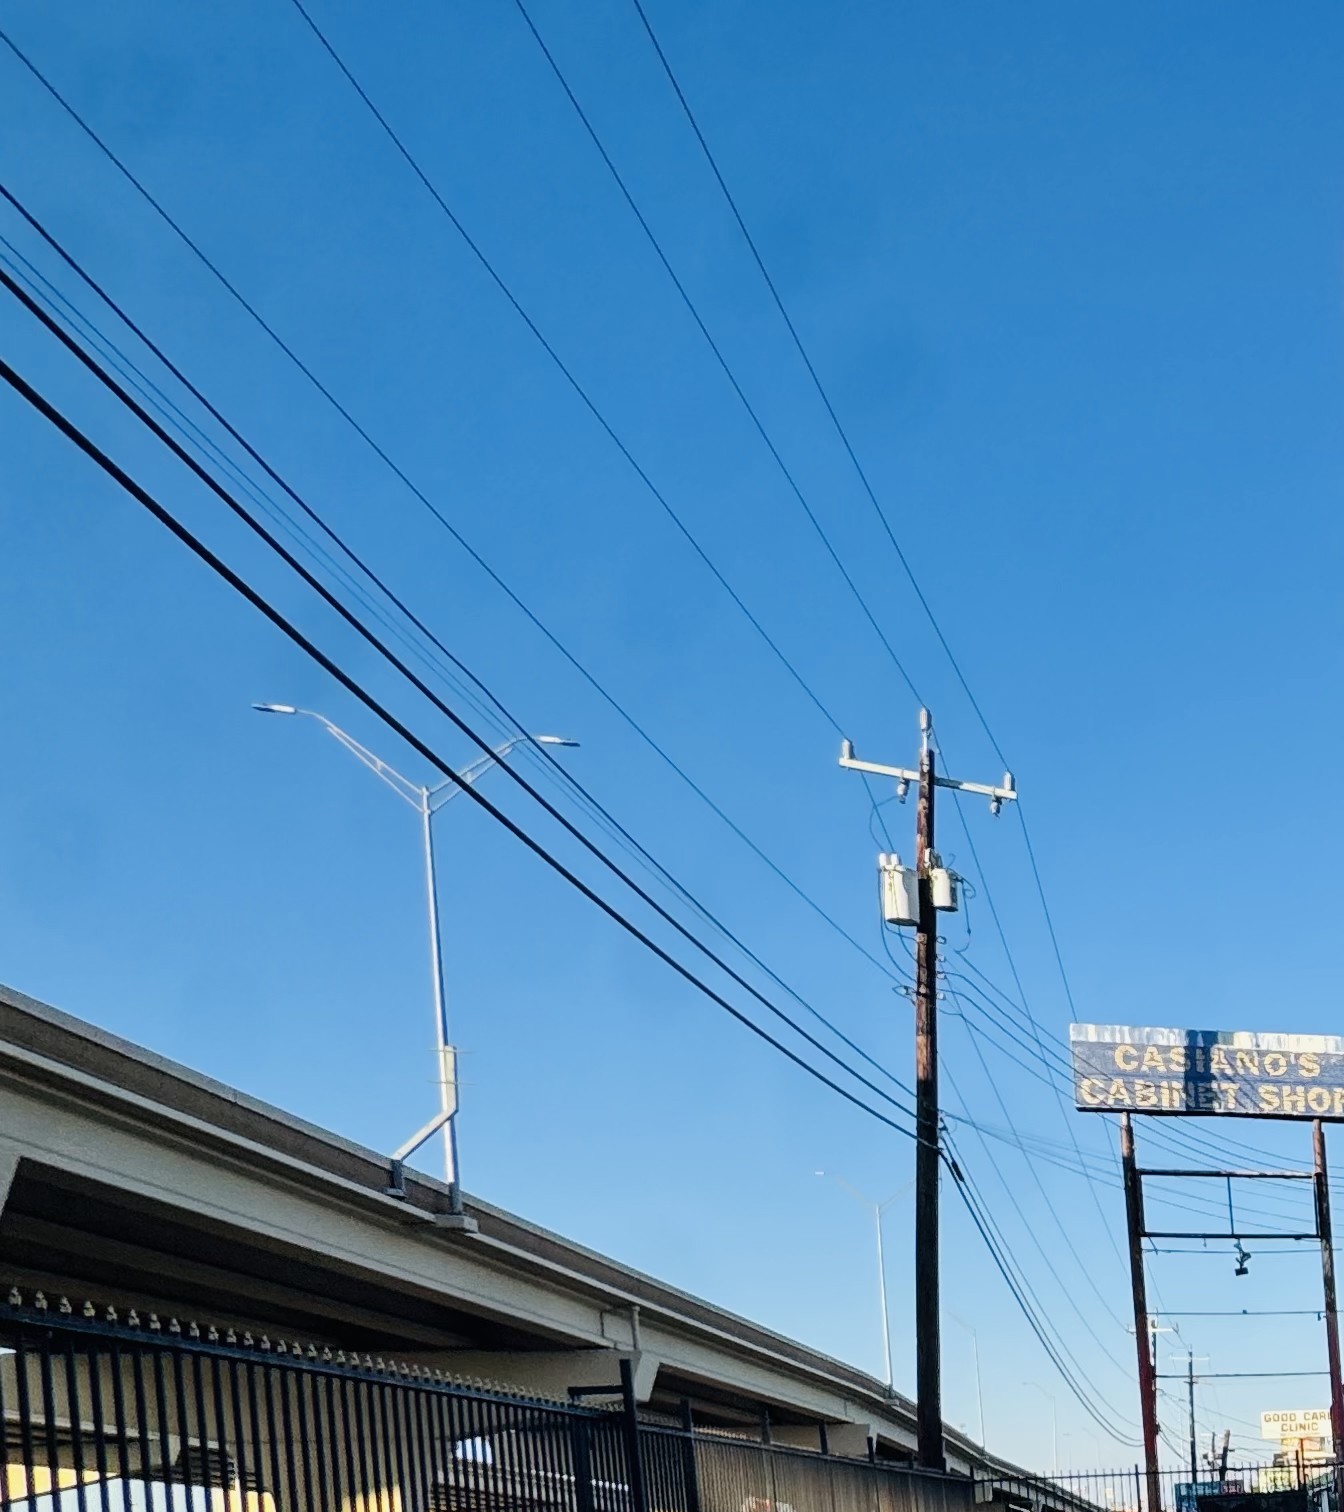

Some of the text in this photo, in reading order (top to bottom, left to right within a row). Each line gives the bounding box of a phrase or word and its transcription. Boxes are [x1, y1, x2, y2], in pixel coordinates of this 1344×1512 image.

[1079, 1077, 1241, 1110] CABINET
[1263, 1412, 1297, 1423] GOOD
[1281, 1422, 1319, 1432] CLINIC
